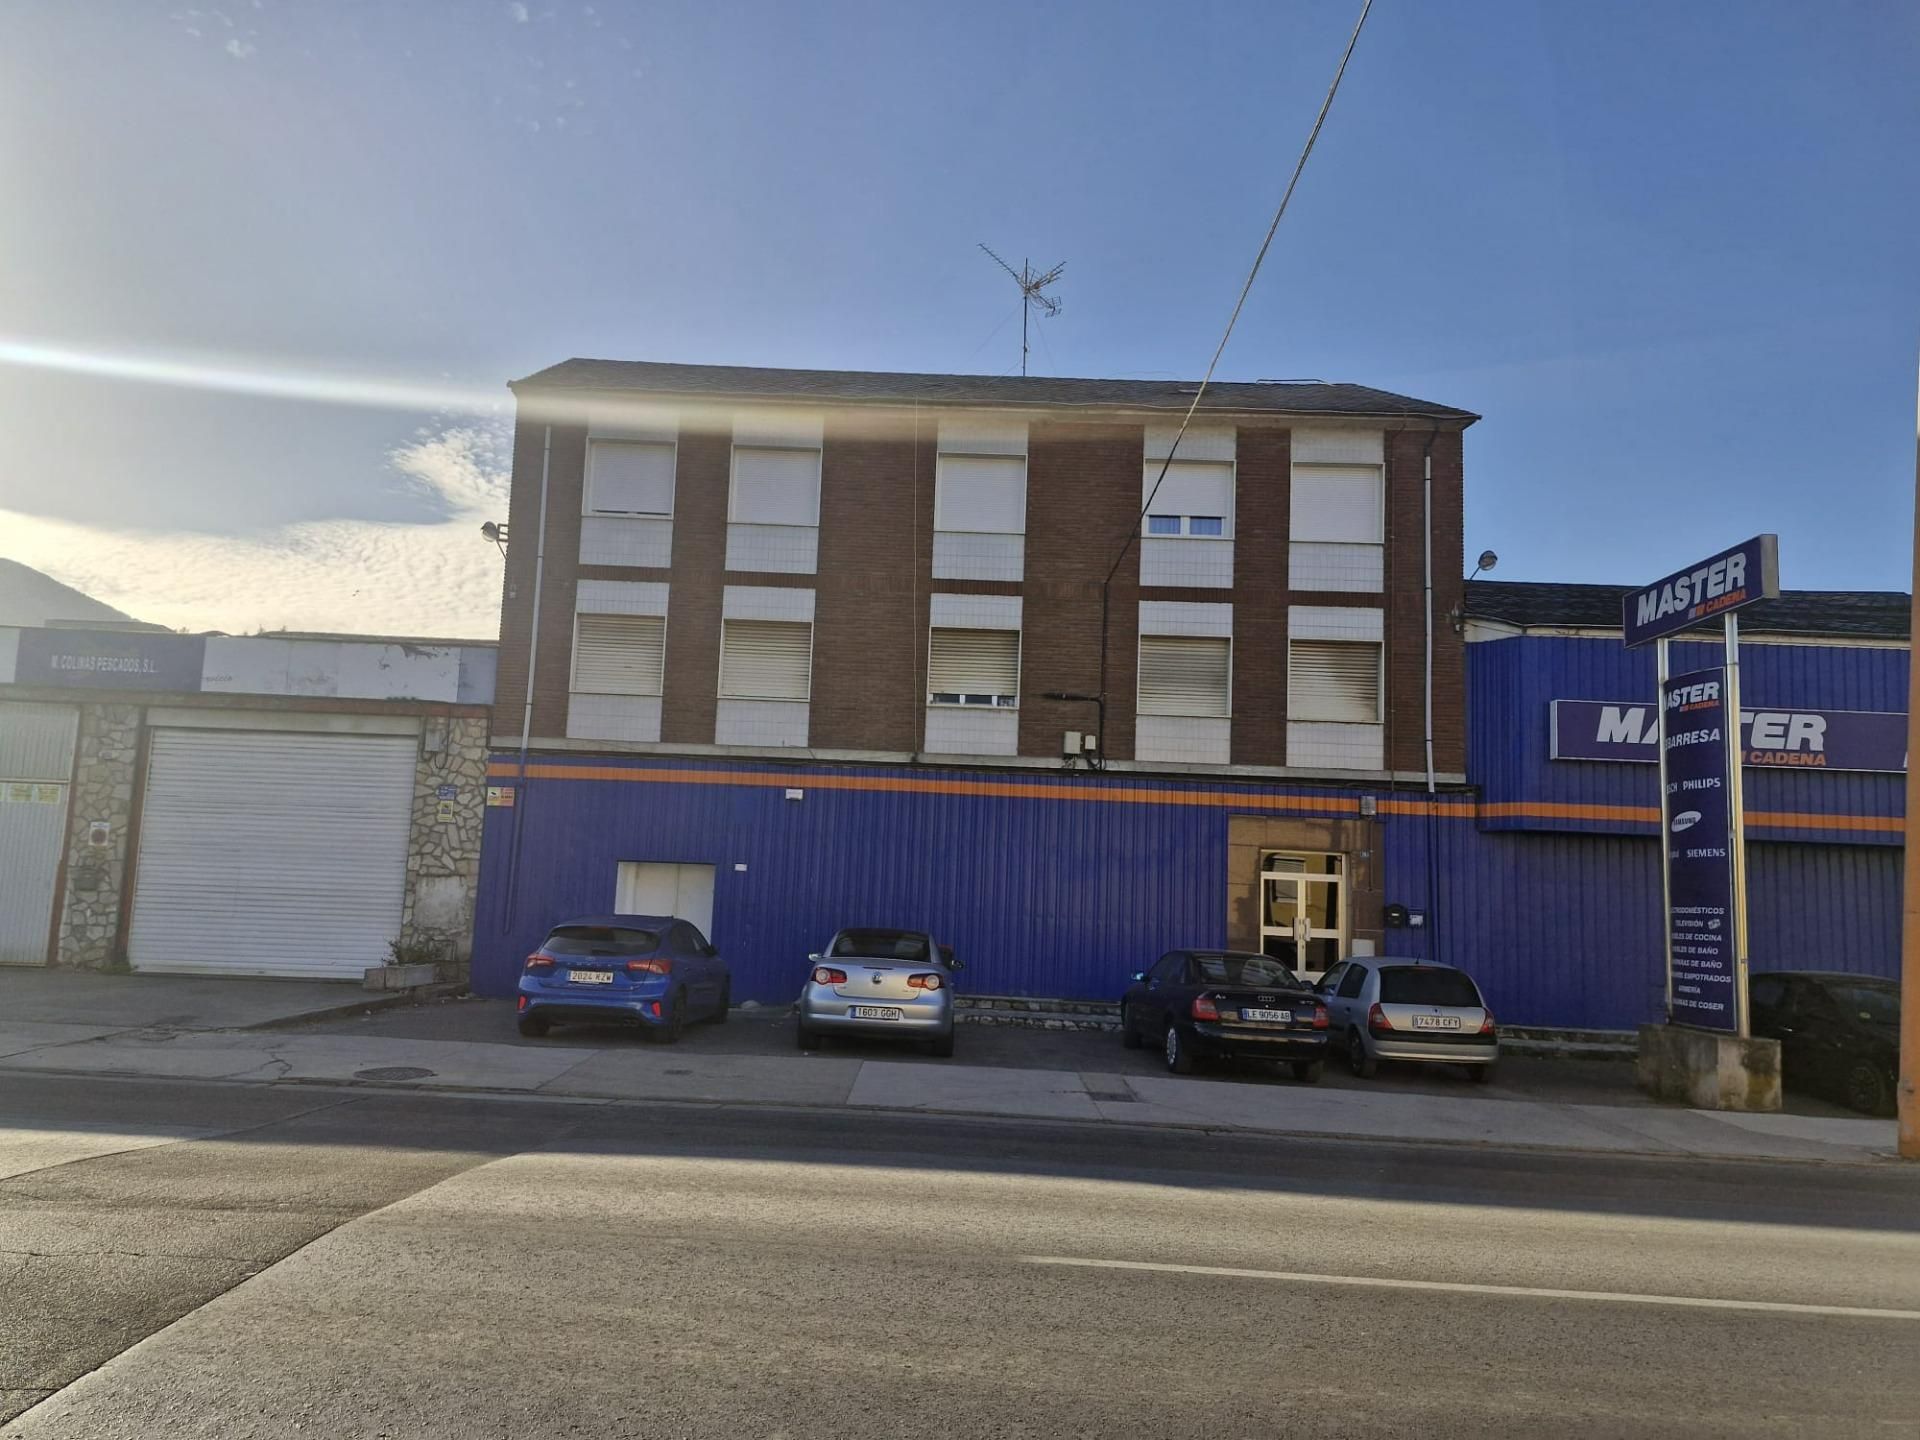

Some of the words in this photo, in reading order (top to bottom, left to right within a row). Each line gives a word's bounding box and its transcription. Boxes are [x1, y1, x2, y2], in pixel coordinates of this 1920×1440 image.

[1637, 552, 1746, 627] MASTER
[1707, 588, 1746, 613] CADENA
[61, 655, 96, 671] COLINAS
[1750, 751, 1827, 767] CADENA
[1683, 778, 1721, 790] PHILIPS
[1687, 848, 1726, 858] SIEMENS
[1694, 933, 1722, 941] COCINA
[1697, 946, 1719, 955] BAÑO
[1701, 959, 1723, 969] BAÑO
[1698, 1001, 1724, 1011] COSER
[858, 1007, 878, 1016] 1603
[1248, 1009, 1258, 1019] LE
